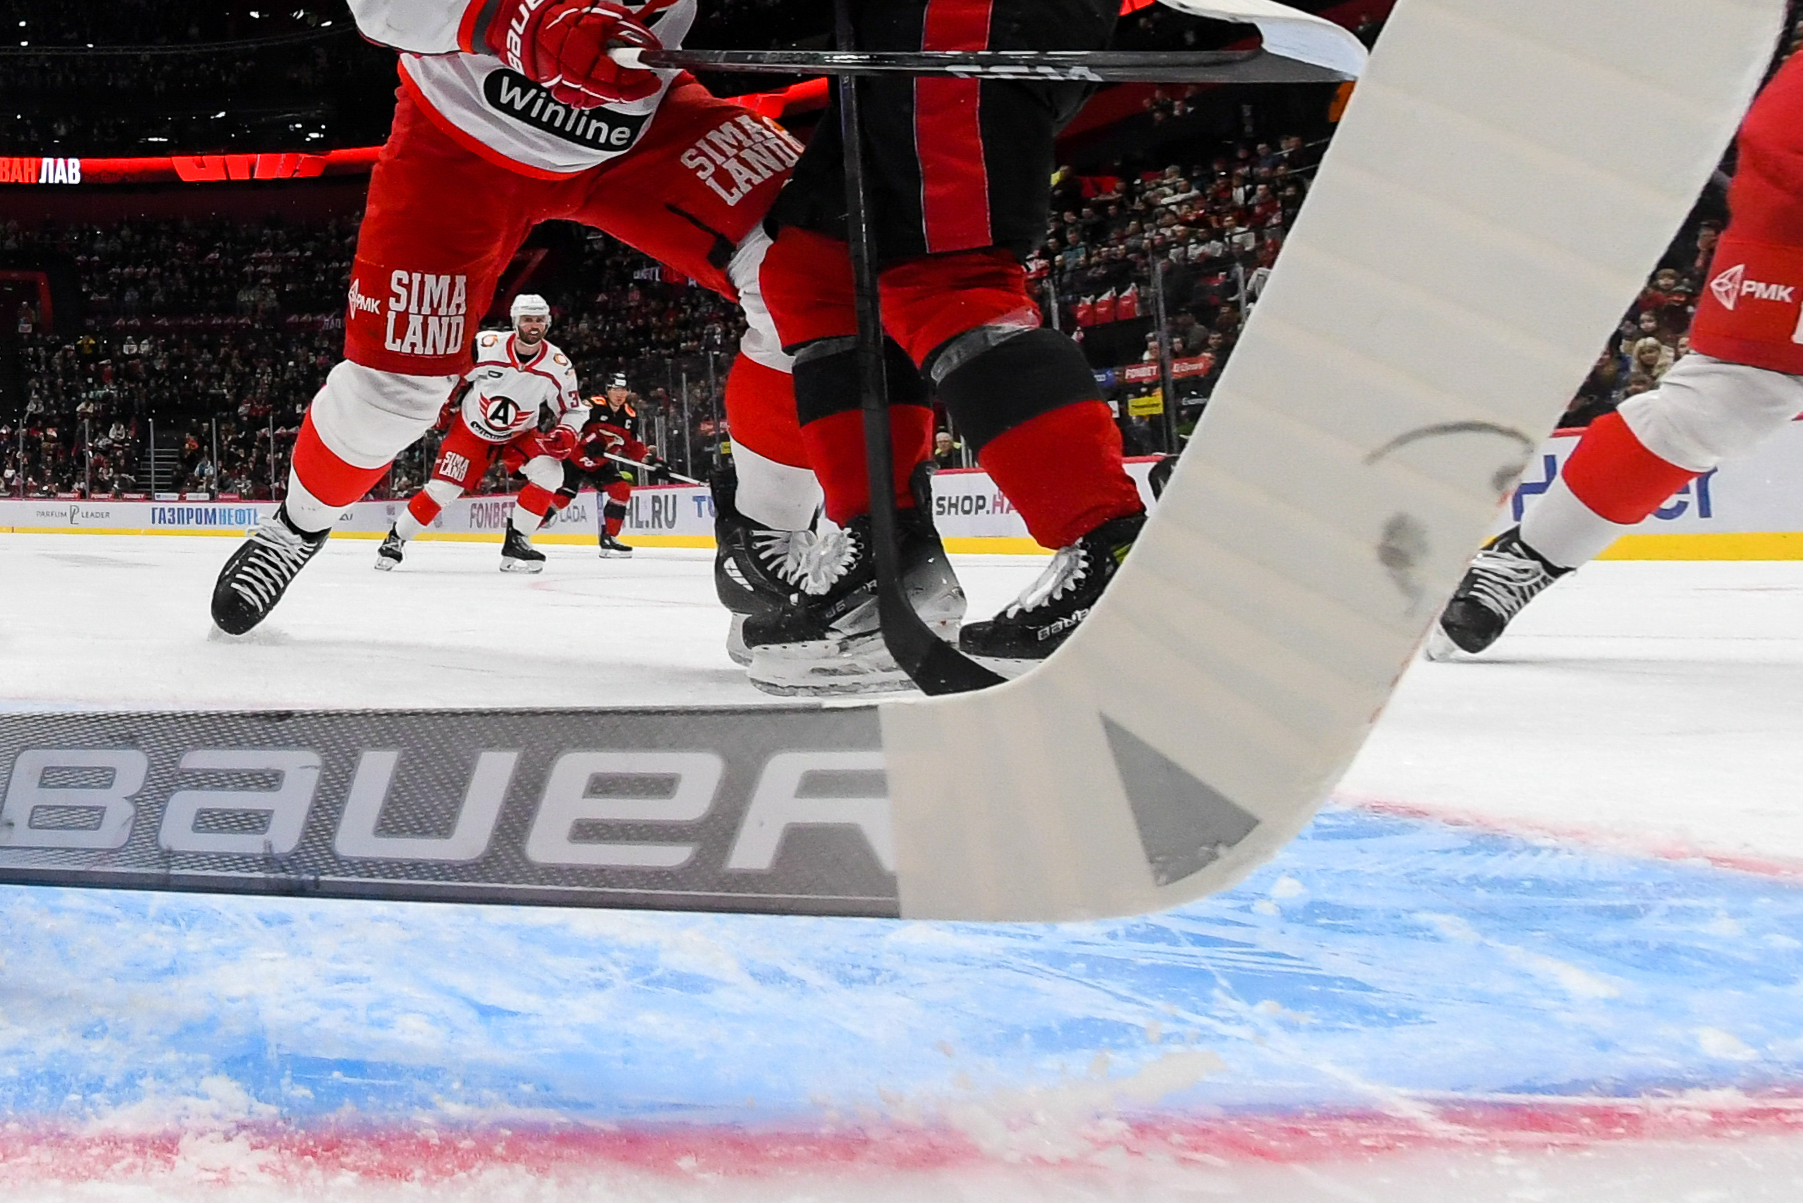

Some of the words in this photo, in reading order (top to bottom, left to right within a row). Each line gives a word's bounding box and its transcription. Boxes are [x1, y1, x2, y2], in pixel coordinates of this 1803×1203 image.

[500, 74, 632, 147] Winline
[680, 114, 777, 181] SIMA
[38, 157, 82, 185] ЛАВ
[704, 138, 800, 207] LAND
[389, 269, 467, 315] SIMA
[1741, 279, 1796, 303] РМК
[385, 311, 466, 357] LAND
[1125, 365, 1158, 380] FONBET
[439, 461, 467, 482] LAND
[445, 451, 470, 472] SIMA
[36, 510, 67, 519] PARFUM
[81, 510, 111, 519] LEADER
[469, 501, 516, 529] FONBET
[626, 494, 677, 529] HL.RU
